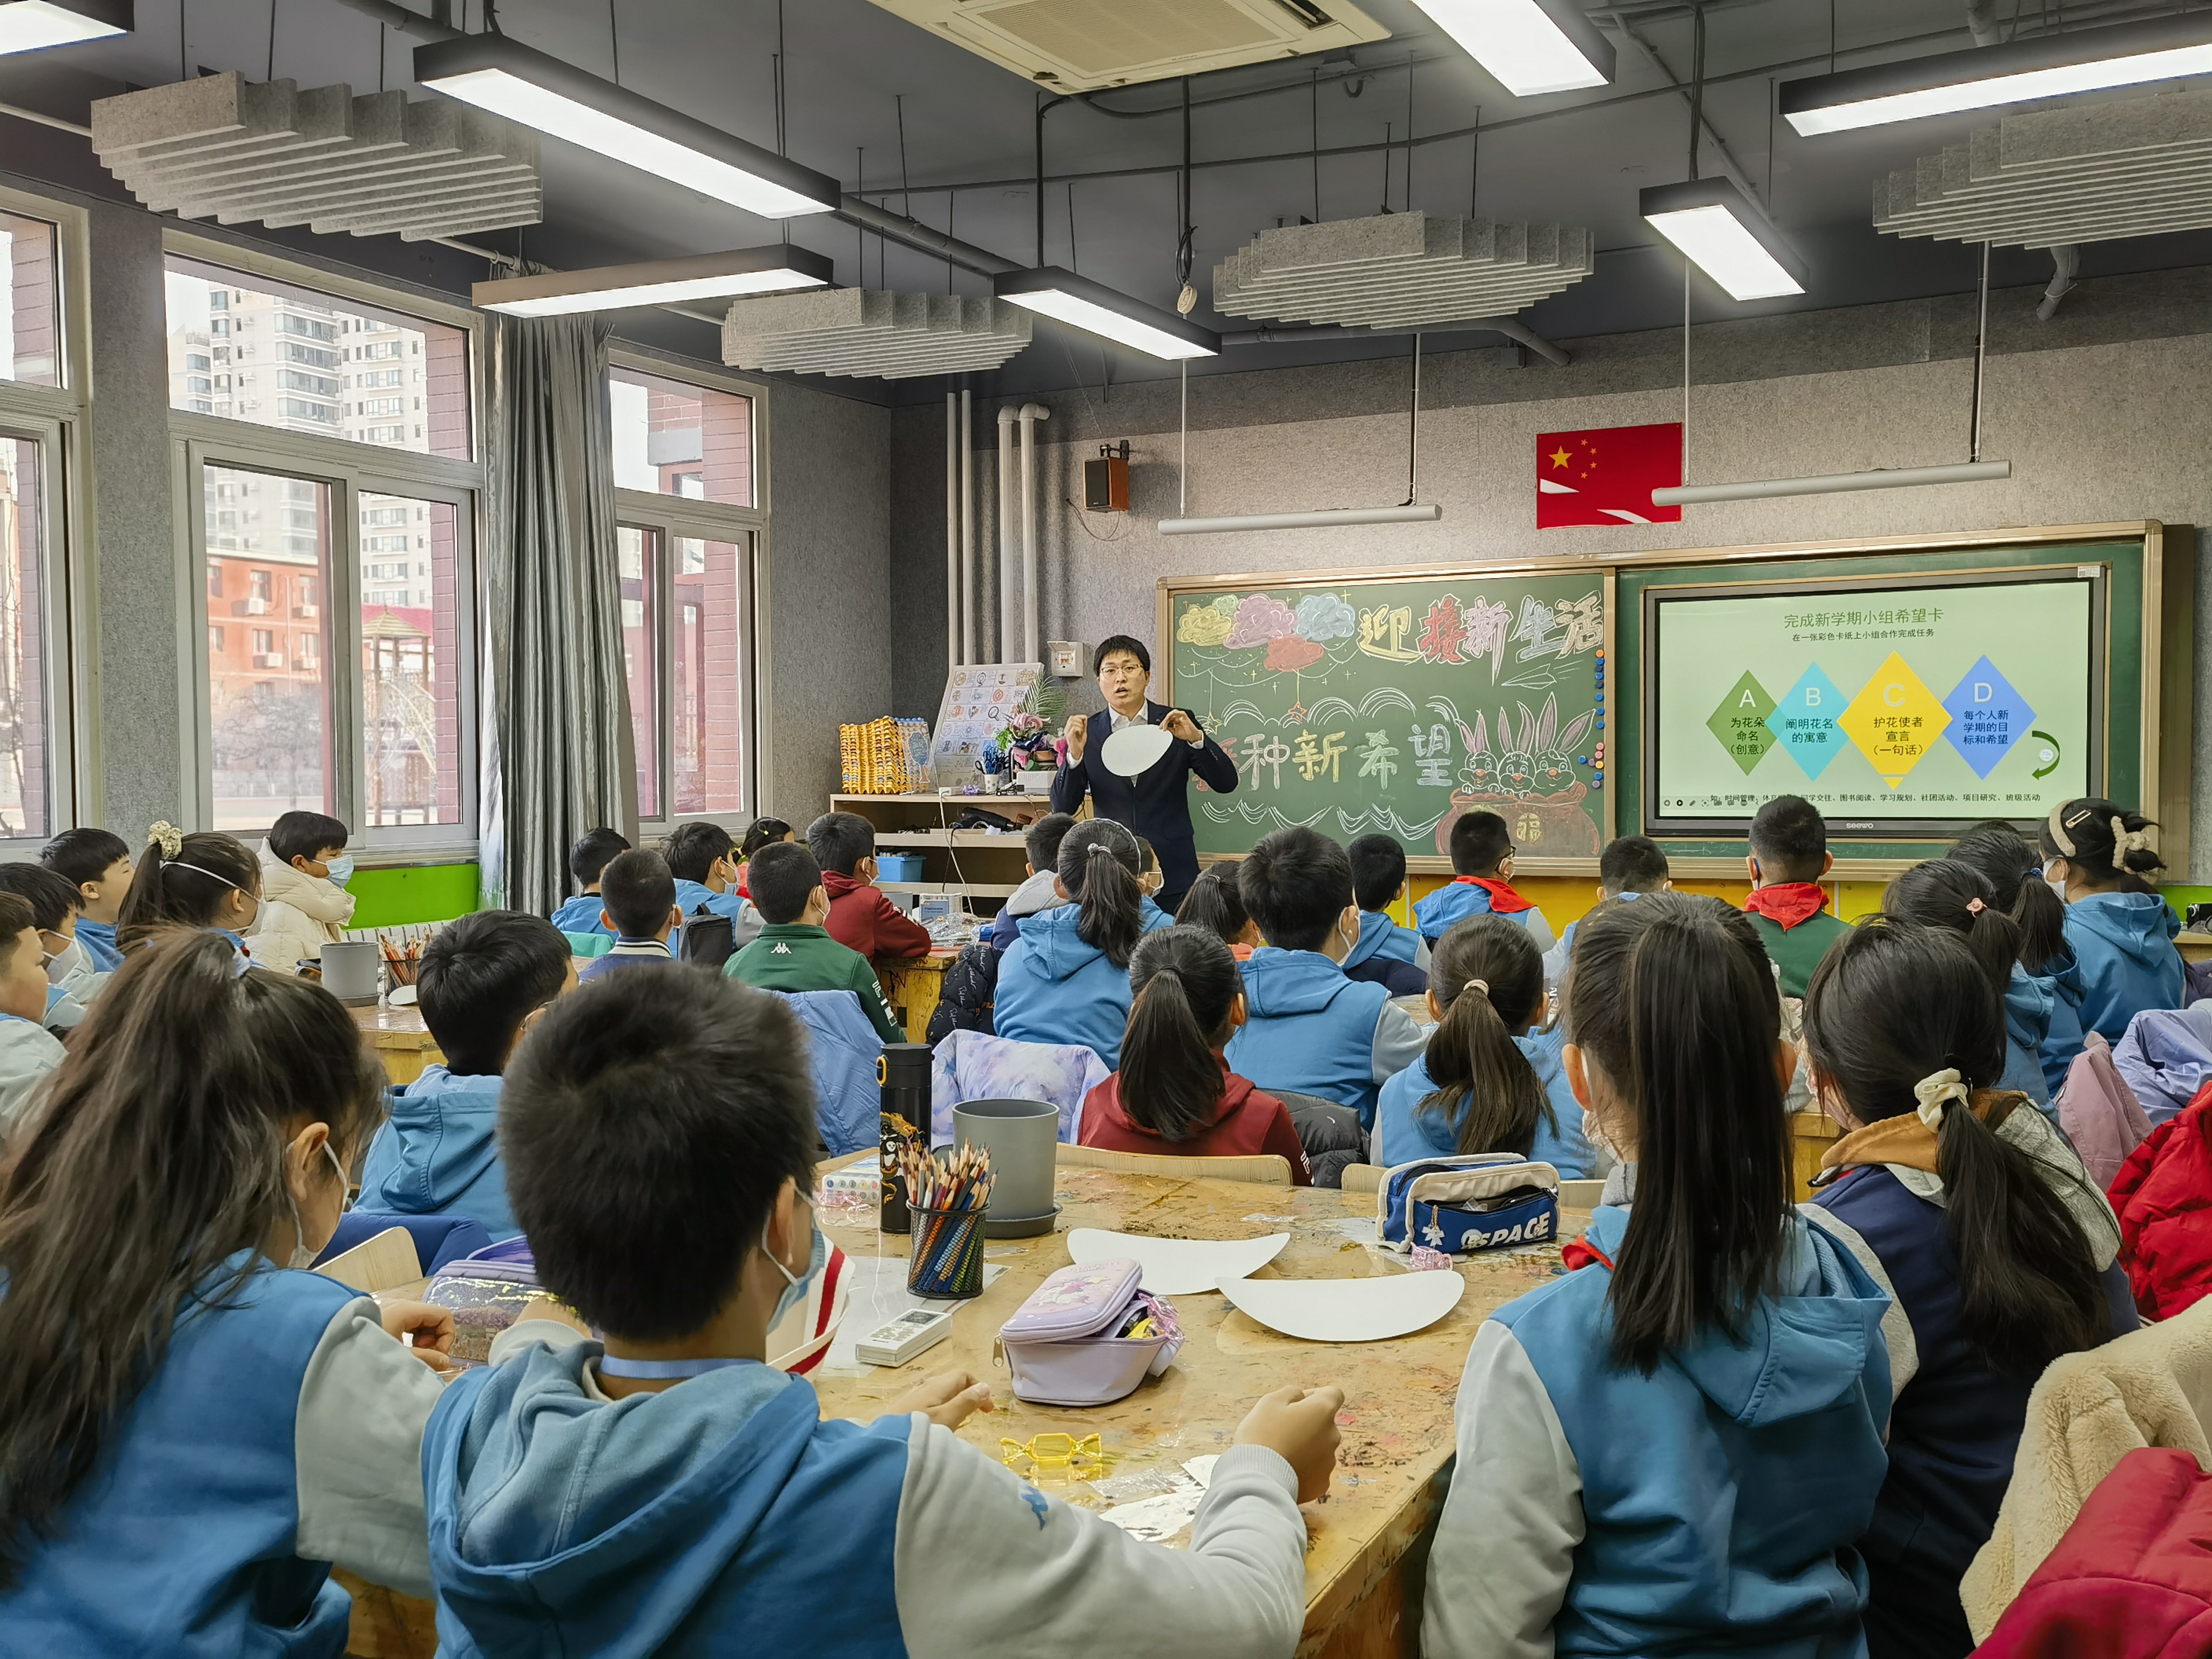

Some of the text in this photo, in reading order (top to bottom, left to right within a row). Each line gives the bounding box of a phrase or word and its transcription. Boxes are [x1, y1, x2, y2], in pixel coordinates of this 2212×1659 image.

[1784, 608, 1944, 628] 完成新学期小组希望卡
[1357, 590, 1606, 686] 迎接新生活
[1792, 628, 1934, 642] 在一张彩色卡纸上小组合作完成任务
[1739, 689, 1756, 707] A
[1806, 687, 1821, 706] B
[1884, 683, 1906, 707] C
[1974, 683, 1993, 703] D
[1964, 710, 2009, 720] 每个人新
[1730, 717, 1765, 728] 为花朵
[1785, 718, 1833, 730] 阐明花名
[1873, 716, 1924, 728] 护花使者
[1964, 722, 2008, 733] 学期的目
[1736, 731, 1758, 742] 命名
[1792, 732, 1827, 744] 的寓意
[1886, 731, 1911, 743] 宣言
[1963, 734, 2009, 745] 标和希望
[1192, 724, 1454, 792] 种新希望
